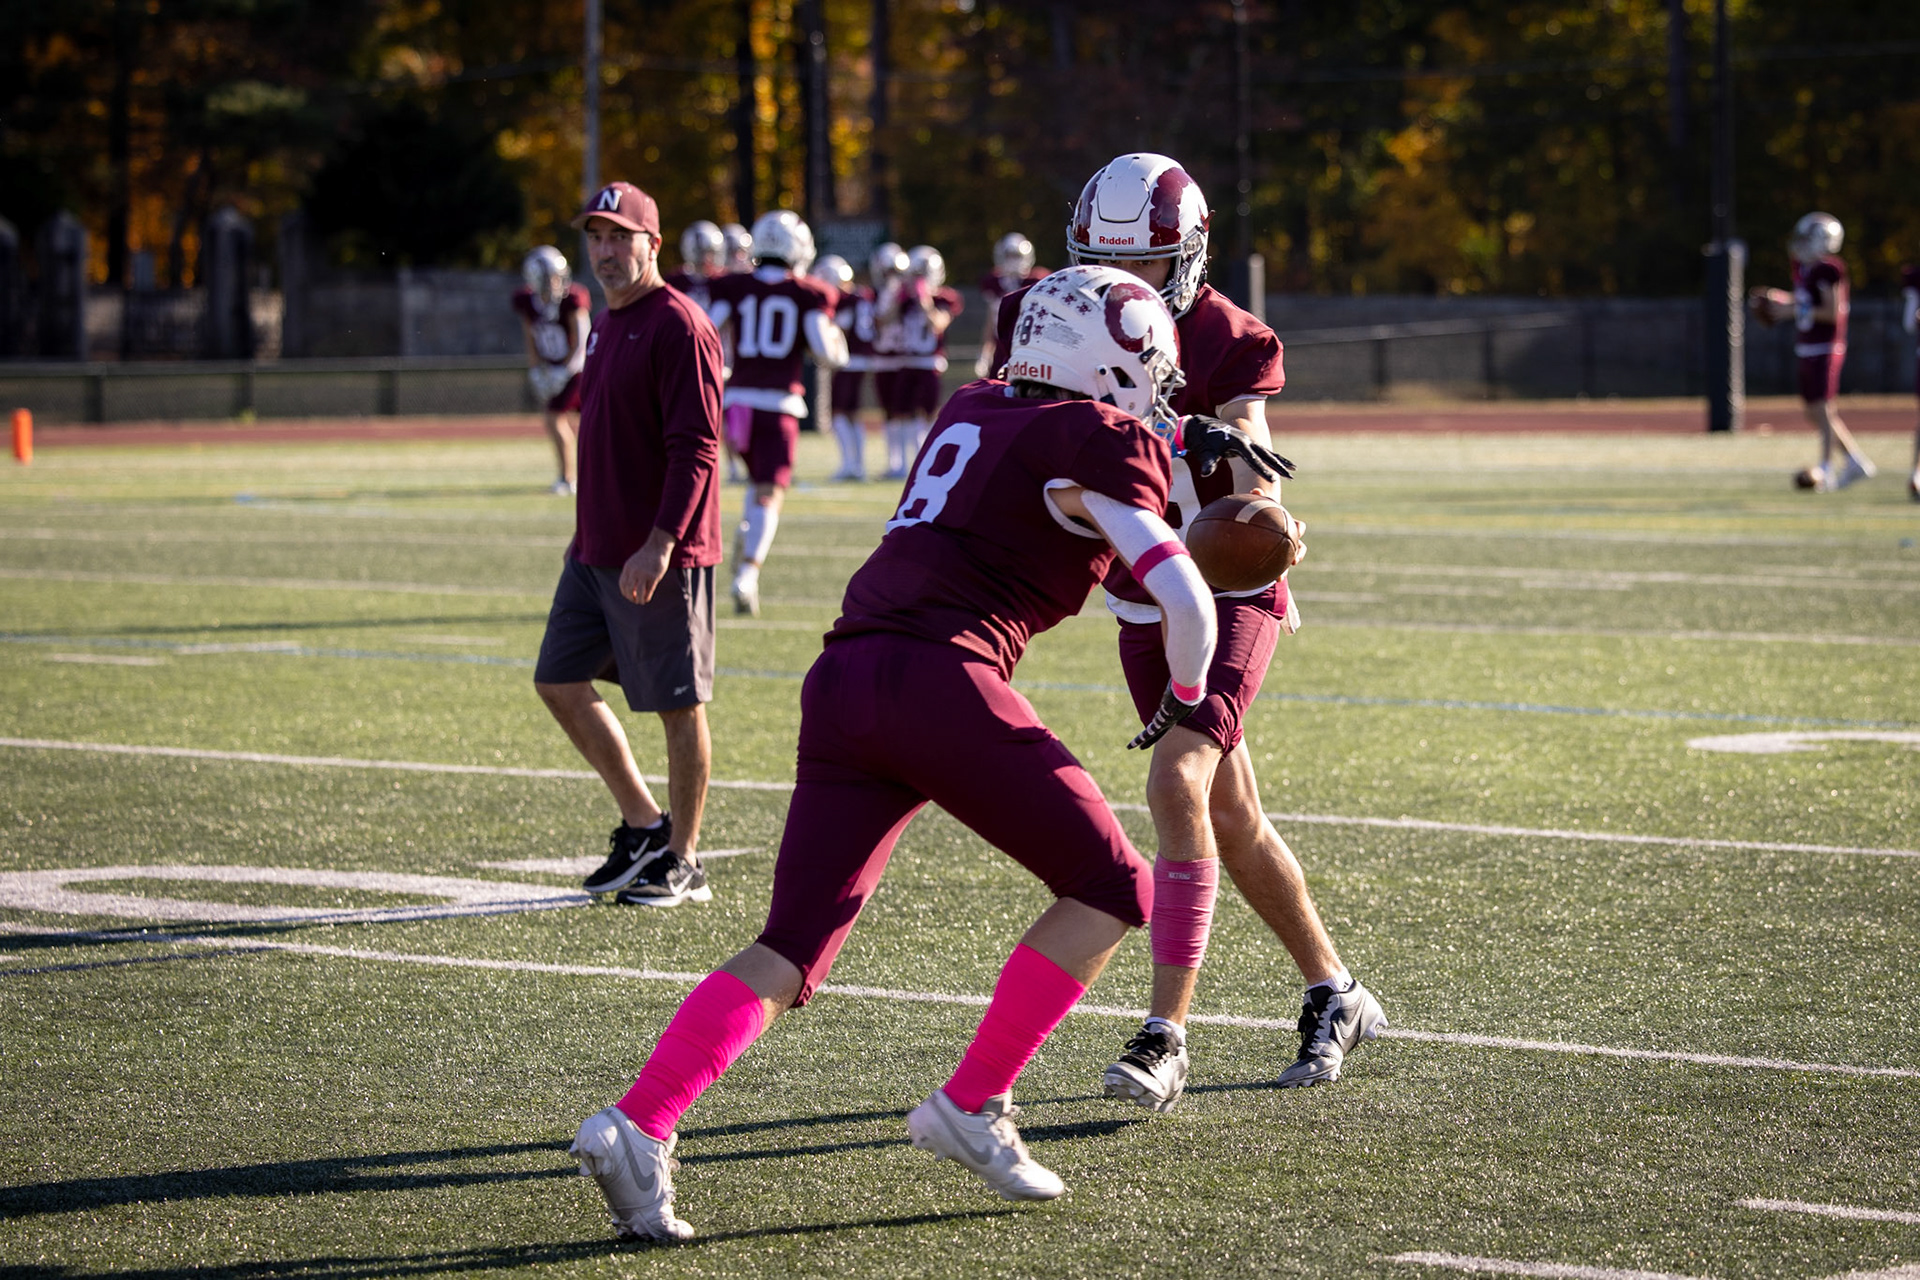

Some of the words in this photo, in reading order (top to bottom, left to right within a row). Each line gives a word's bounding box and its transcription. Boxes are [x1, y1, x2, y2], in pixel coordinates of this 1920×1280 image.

[597, 189, 623, 211] N
[1099, 236, 1135, 245] Riddell
[737, 294, 799, 359] 10
[1019, 315, 1034, 346] 8
[885, 422, 981, 534] 8
